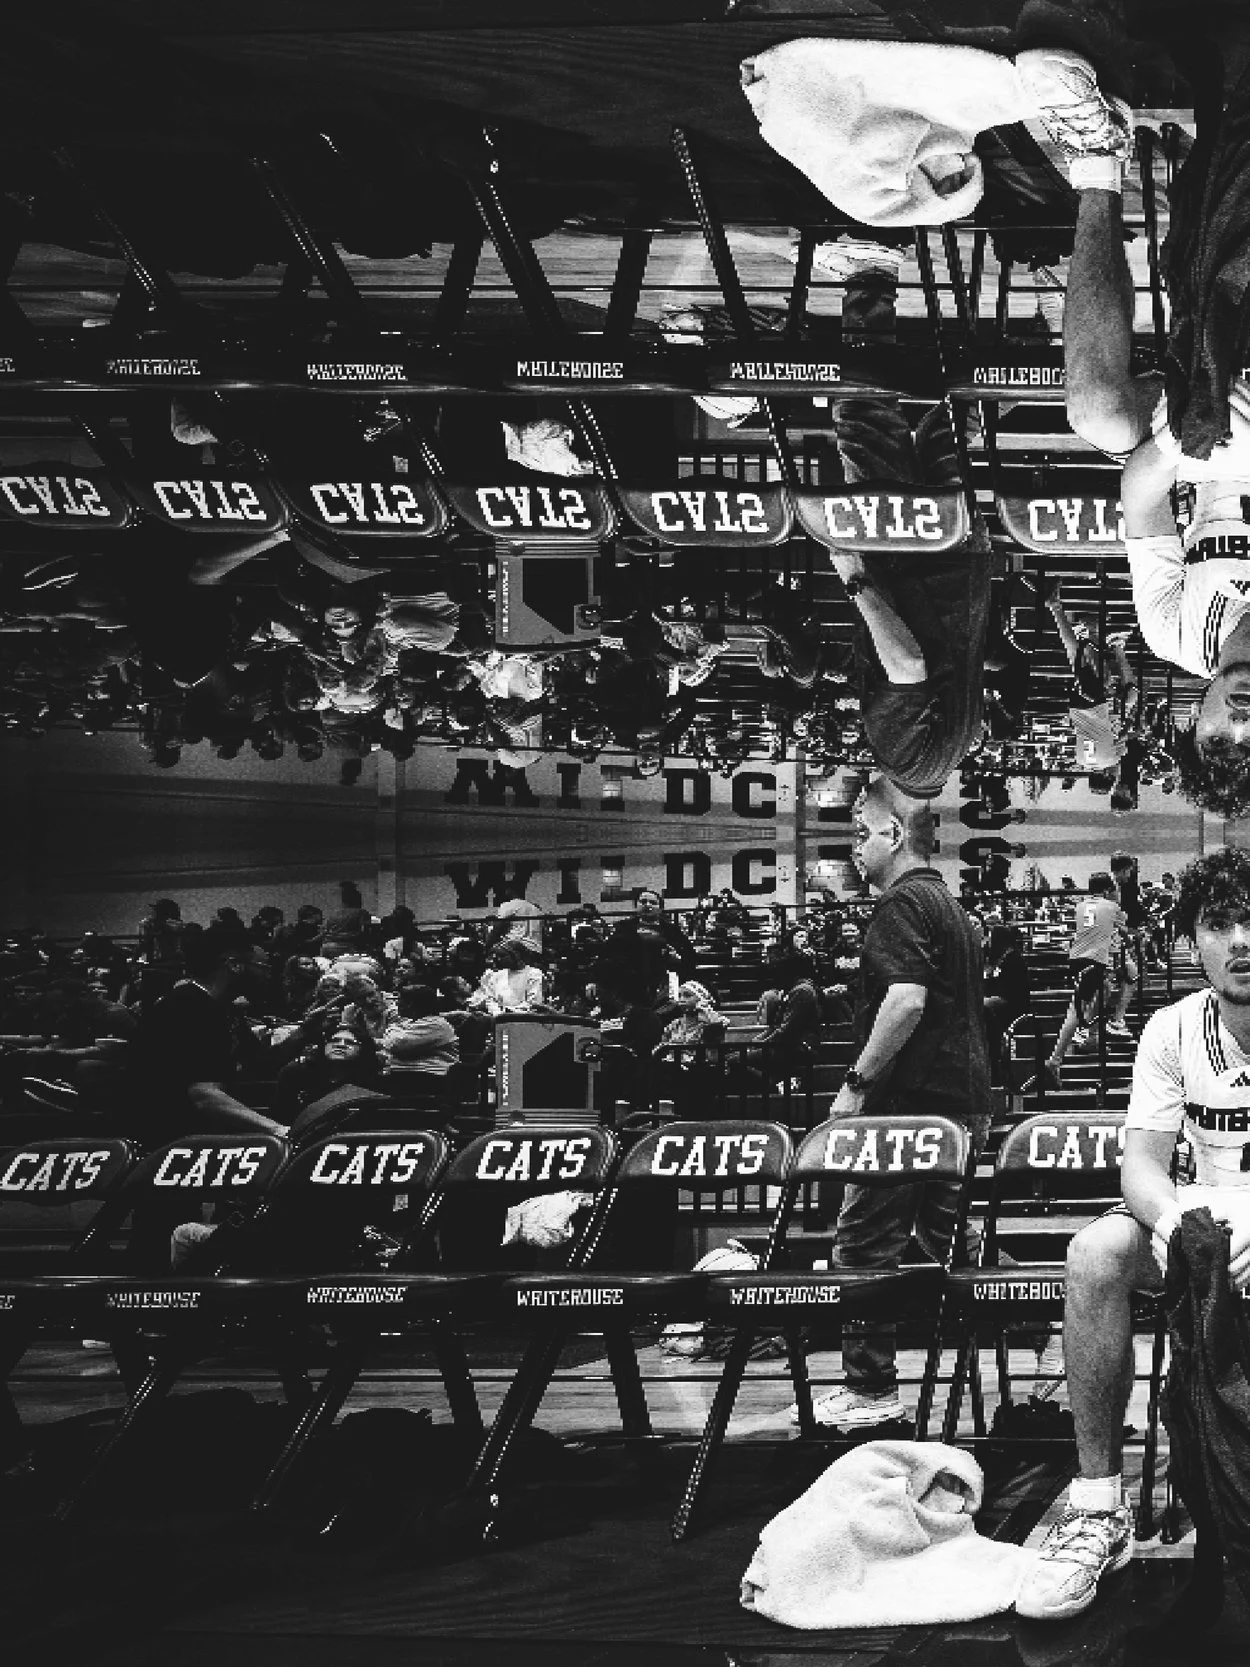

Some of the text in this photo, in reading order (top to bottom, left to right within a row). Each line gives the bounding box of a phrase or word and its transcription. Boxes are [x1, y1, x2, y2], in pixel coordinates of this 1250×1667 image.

[154, 1147, 267, 1187] CATS
[310, 1142, 425, 1184] CATS
[476, 1137, 592, 1181] CATS
[649, 1134, 768, 1176] CATS
[824, 1127, 943, 1171] CATS
[0, 1151, 110, 1190] CATS
[516, 1288, 624, 1307] WHITEHOUSE
[729, 1285, 841, 1305] WHITEHOUSE
